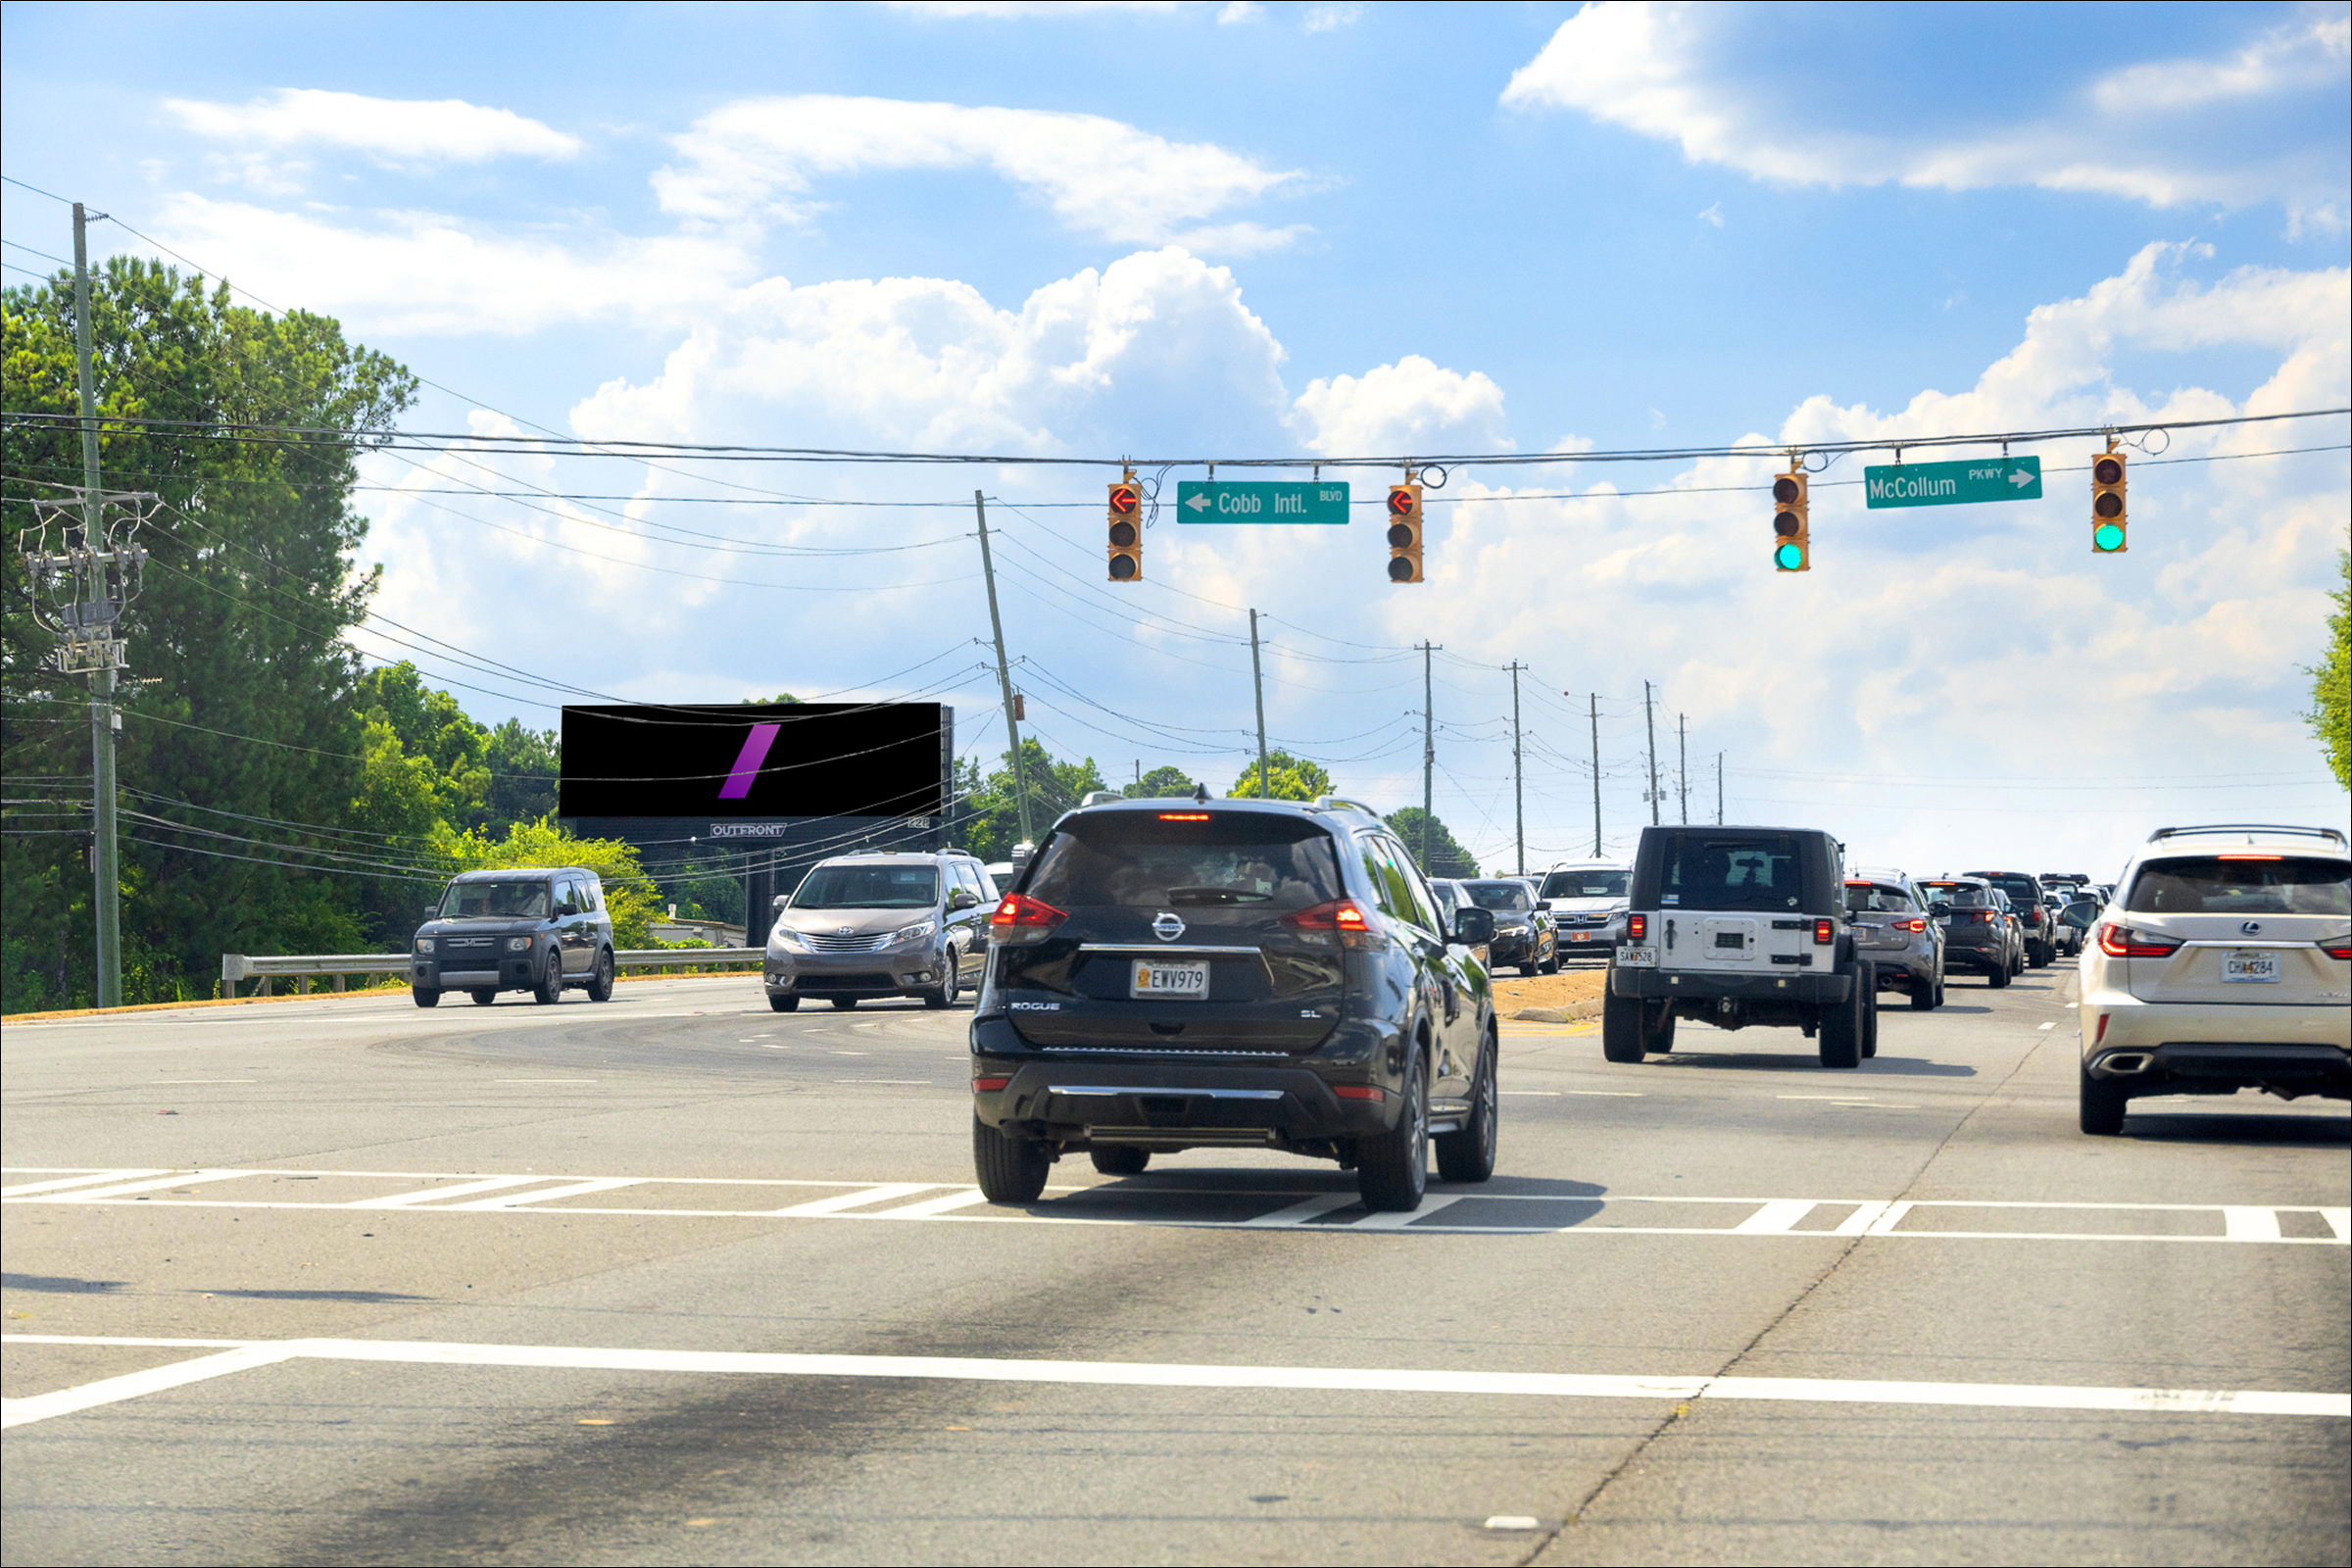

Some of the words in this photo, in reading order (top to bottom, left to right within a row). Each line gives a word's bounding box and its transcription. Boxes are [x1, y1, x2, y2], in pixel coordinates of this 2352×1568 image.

[1870, 476, 1956, 500] McCollum
[1968, 467, 2003, 480] PKWY
[1218, 492, 1262, 514] Cobb
[1274, 493, 1307, 514] Intl.
[1319, 490, 1343, 502] BLVD
[712, 824, 784, 836] OUTFRONT
[1152, 969, 1203, 989] EWV979
[1010, 1002, 1060, 1010] ROGUE
[1300, 1009, 1322, 1018] SL
